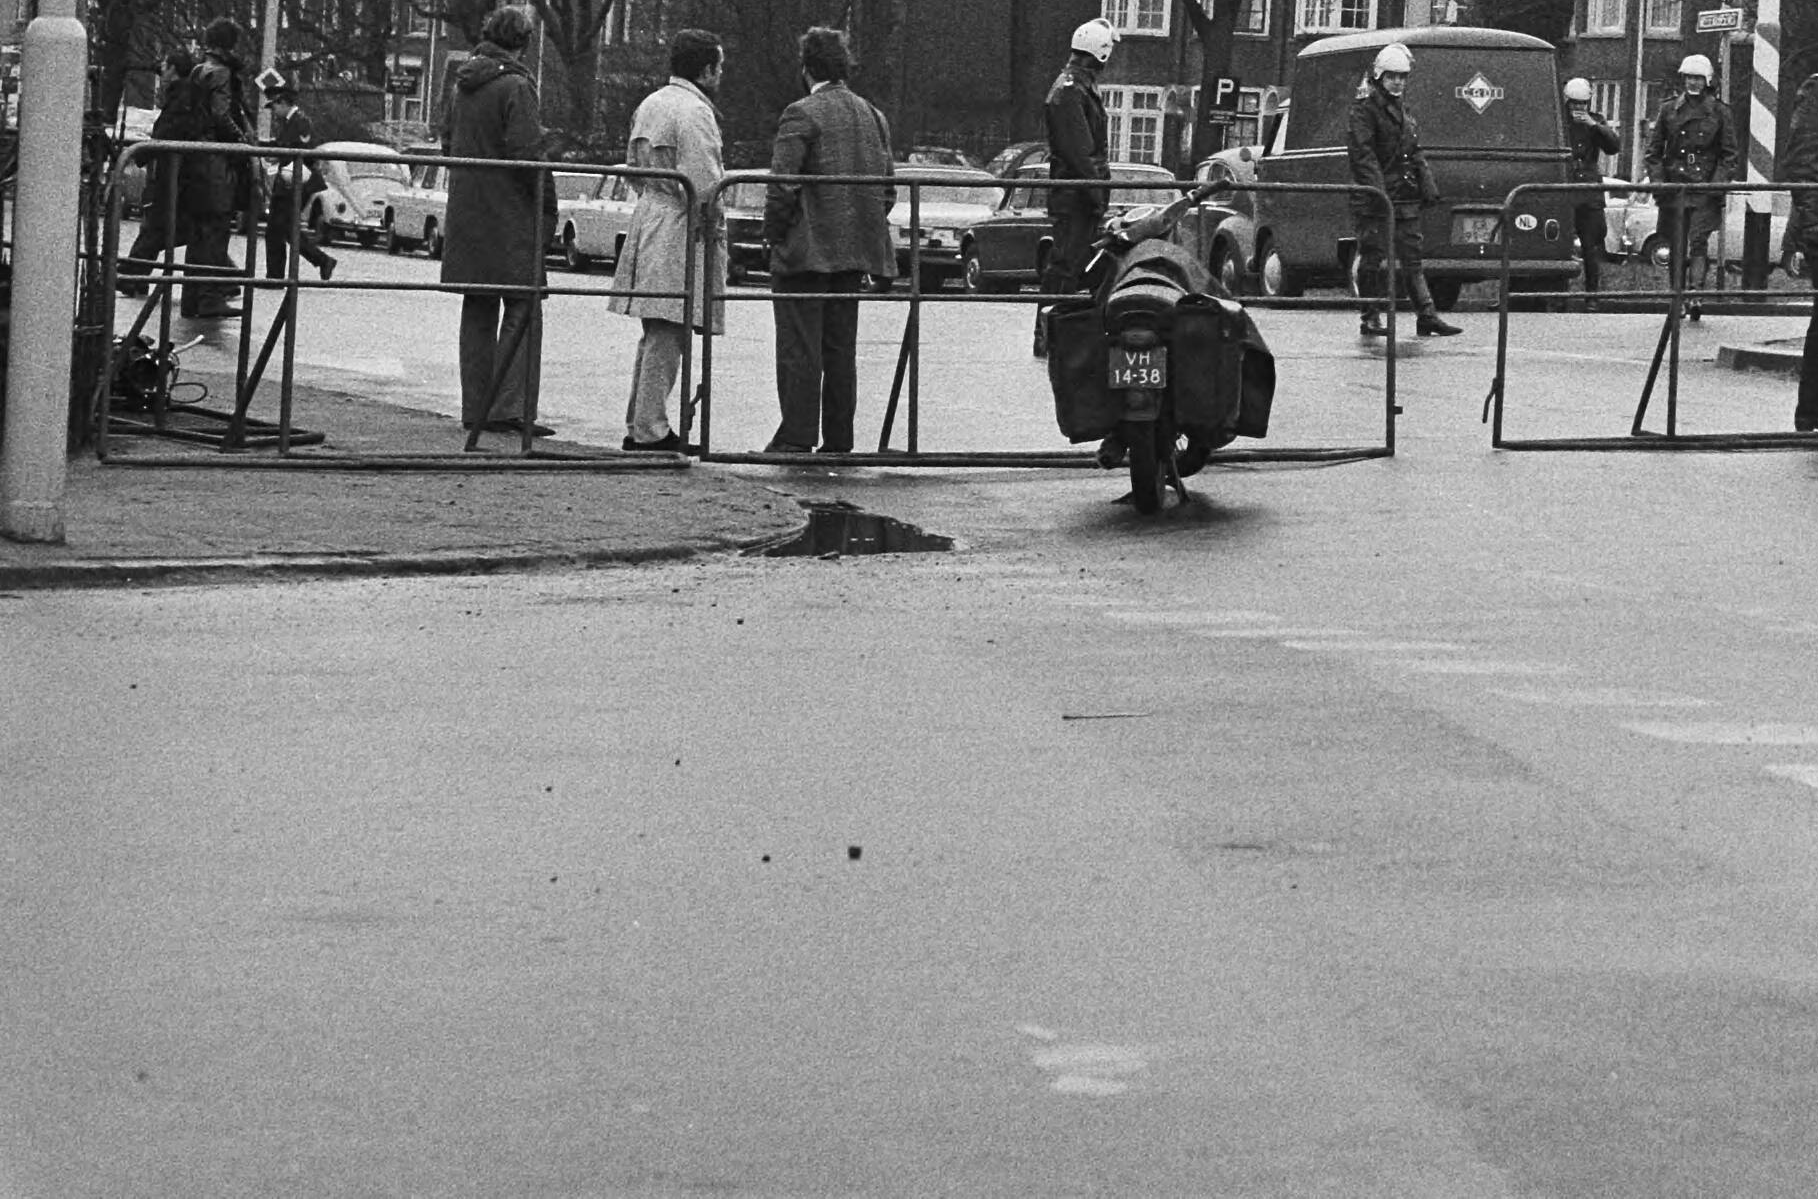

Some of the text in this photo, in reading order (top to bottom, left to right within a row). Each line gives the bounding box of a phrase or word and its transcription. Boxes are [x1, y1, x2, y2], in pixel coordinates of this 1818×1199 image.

[1216, 78, 1234, 105] P
[1519, 216, 1533, 228] NL
[1125, 351, 1150, 366] VH
[1115, 369, 1160, 384] 14-38
